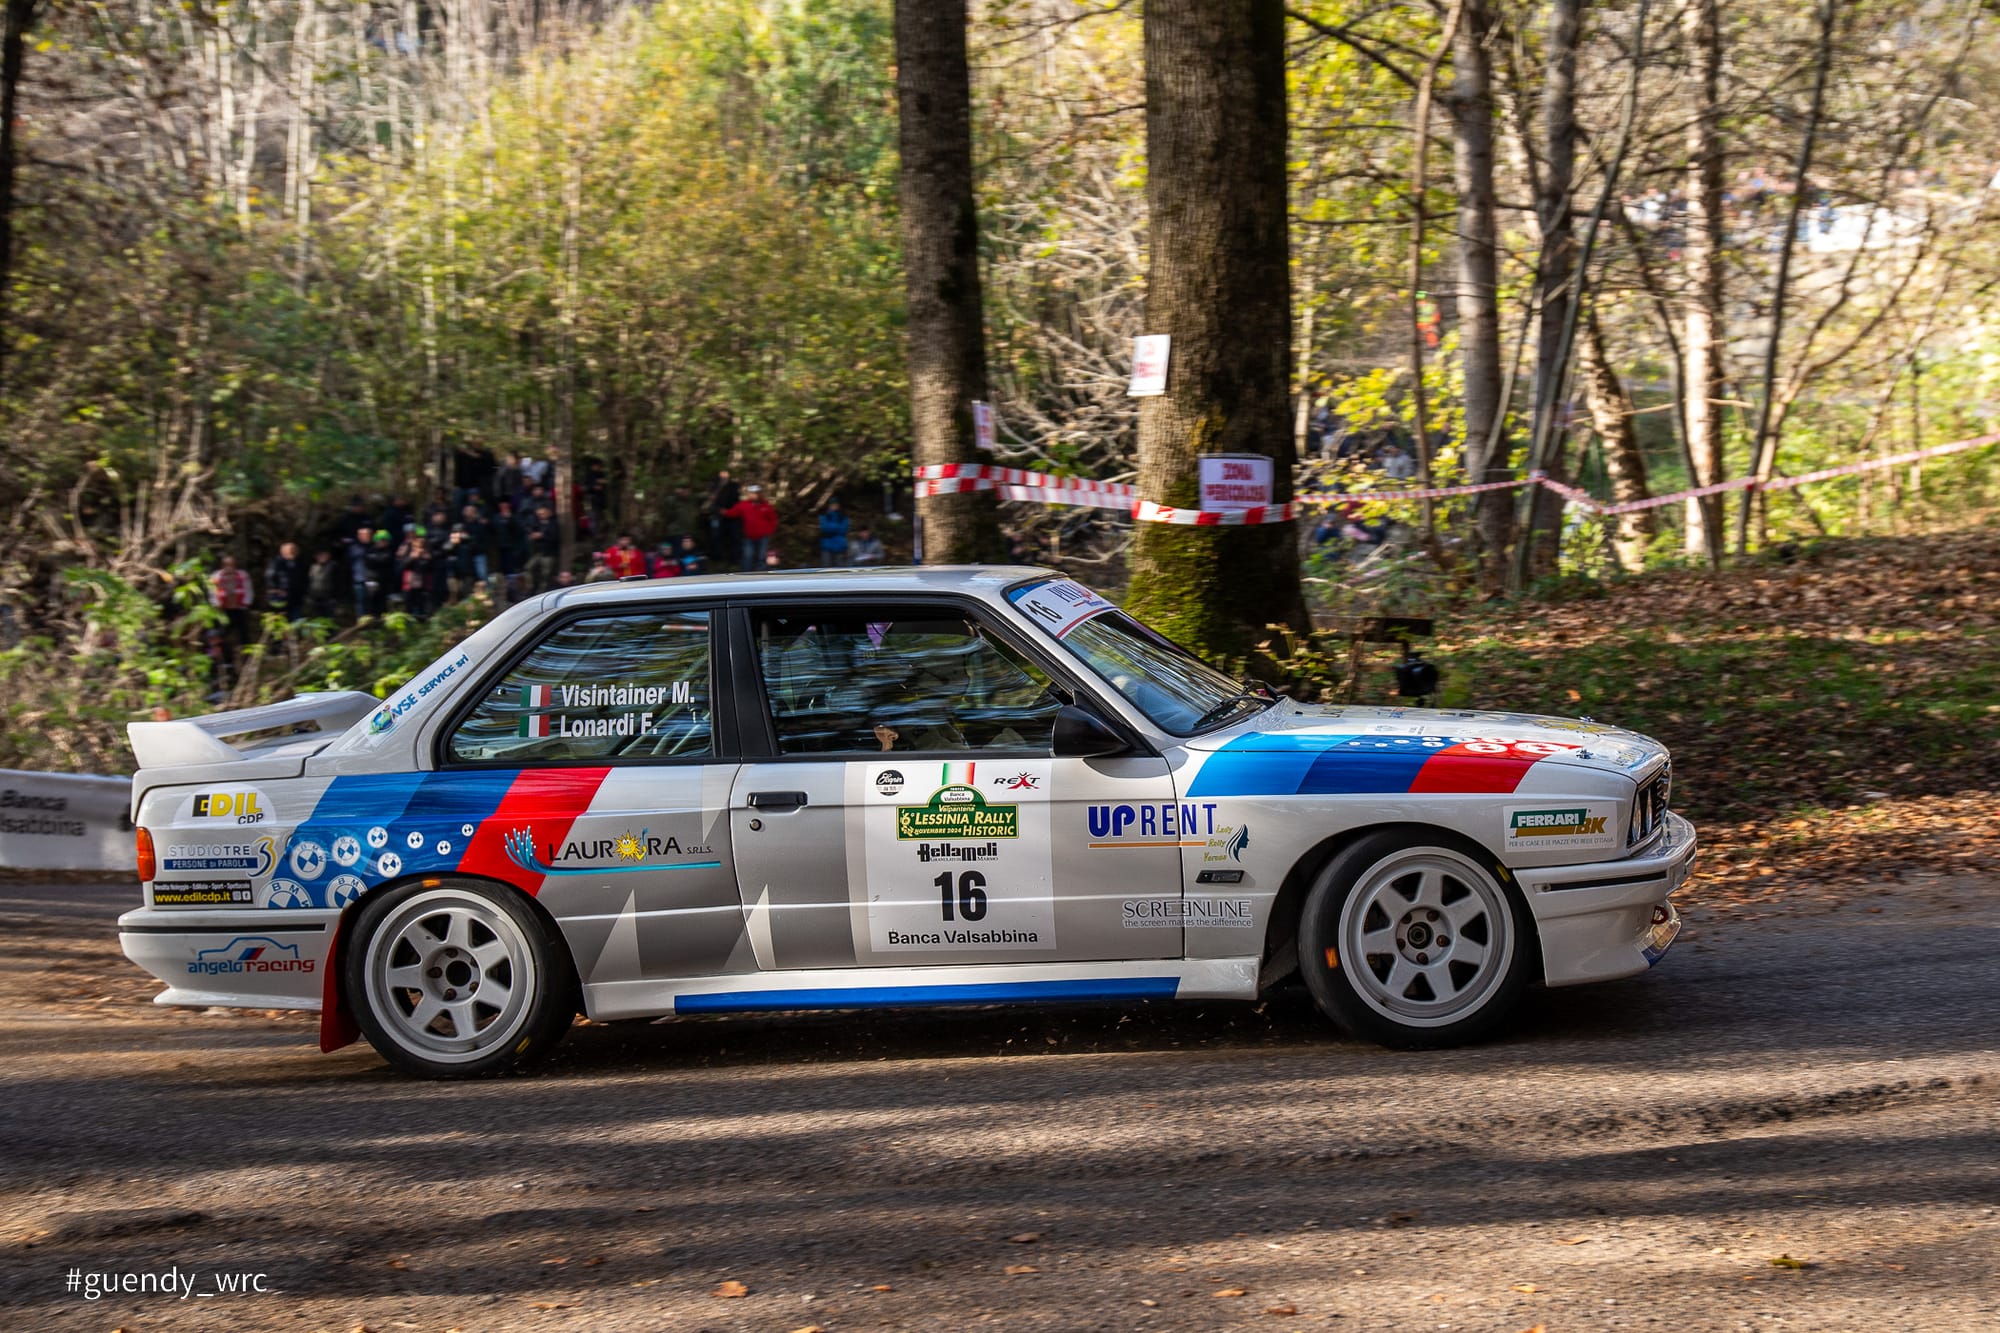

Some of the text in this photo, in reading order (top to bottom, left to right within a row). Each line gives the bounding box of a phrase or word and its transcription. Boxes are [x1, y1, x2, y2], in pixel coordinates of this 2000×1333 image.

[1025, 599, 1062, 624] 16
[418, 664, 456, 697] SERVICE
[561, 681, 695, 707] Visintainer M.
[560, 712, 658, 738] Lonardi F.
[192, 792, 262, 817] EDIL
[238, 812, 264, 825] CDP
[915, 812, 969, 825] LESSINIA
[974, 811, 1014, 824] RALLY
[1517, 813, 1580, 826] FERRARI
[963, 825, 1015, 836] HISTORIC
[917, 842, 998, 862] Bellamoli
[172, 860, 207, 869] PERSONE
[218, 859, 249, 869] PAROLA
[155, 892, 231, 903] www.edilcdp.it
[934, 870, 987, 922] 16
[1124, 901, 1252, 918] SCREENLINE
[1196, 918, 1210, 926] the
[1212, 918, 1252, 927] difference
[888, 930, 1038, 944] Banca Valsabbina
